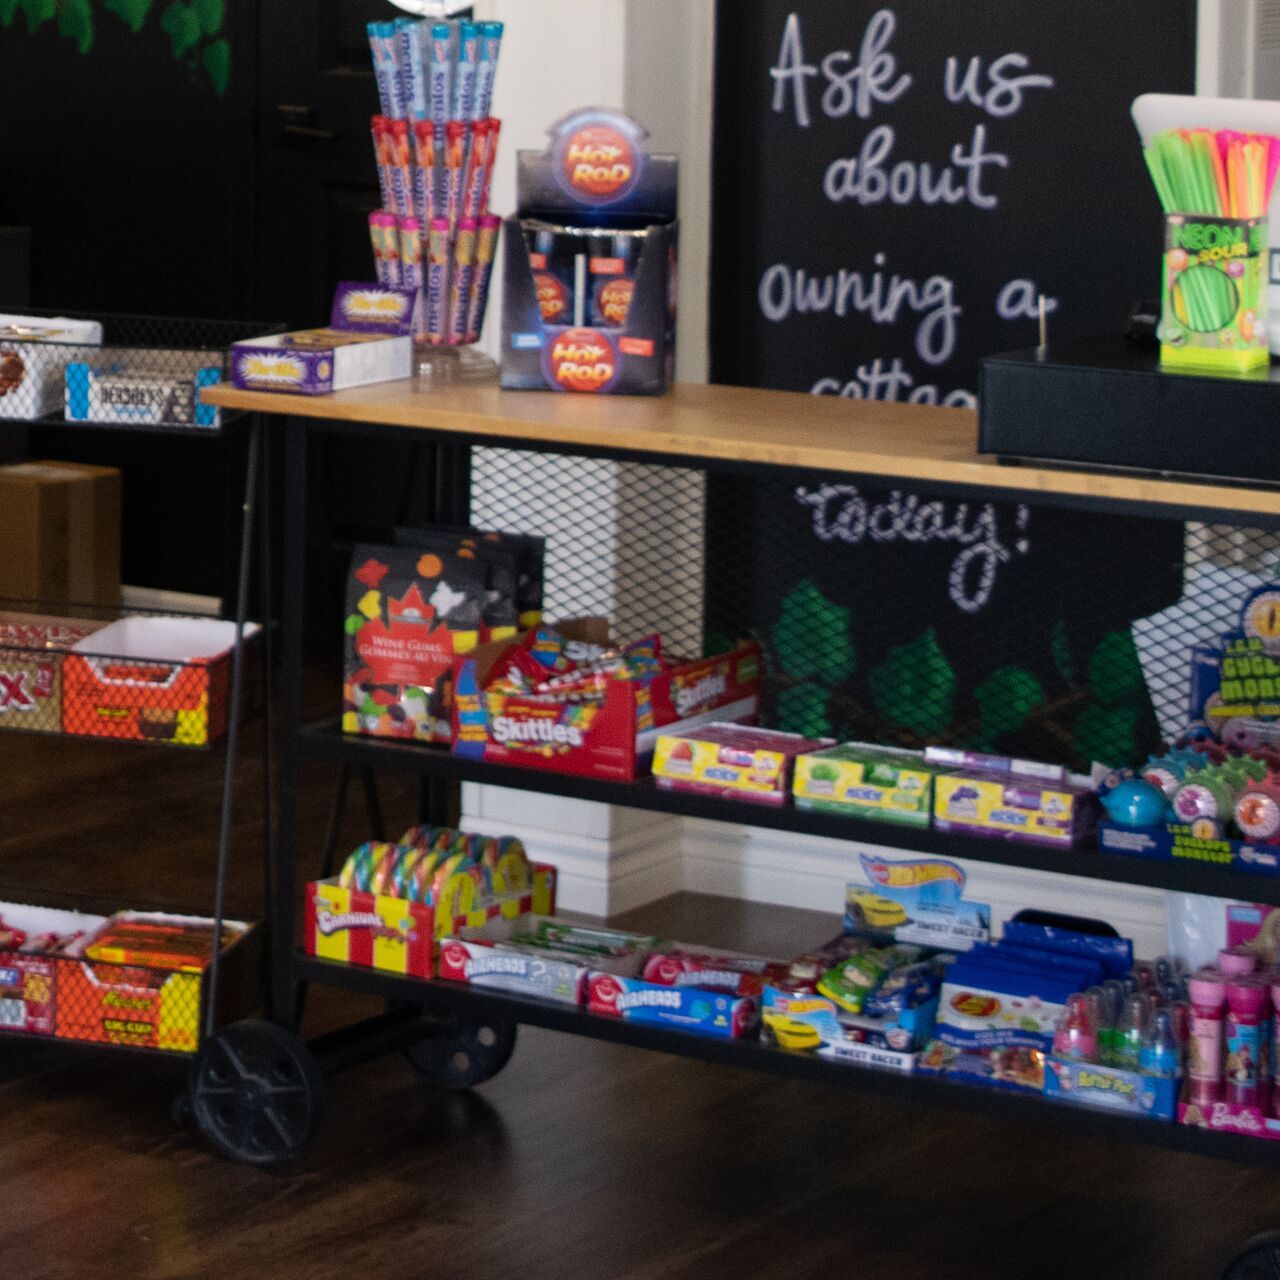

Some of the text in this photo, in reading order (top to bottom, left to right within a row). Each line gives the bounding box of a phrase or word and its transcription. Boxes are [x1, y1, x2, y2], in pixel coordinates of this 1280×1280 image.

[770, 8, 1055, 128] Ask us
[823, 124, 1008, 210] about
[429, 263, 440, 332] mentos
[995, 277, 1058, 320] a
[794, 482, 1031, 614] today!
[676, 675, 727, 719] Skittles
[490, 715, 584, 747] Skittles
[1210, 1102, 1262, 1131] Barbie
